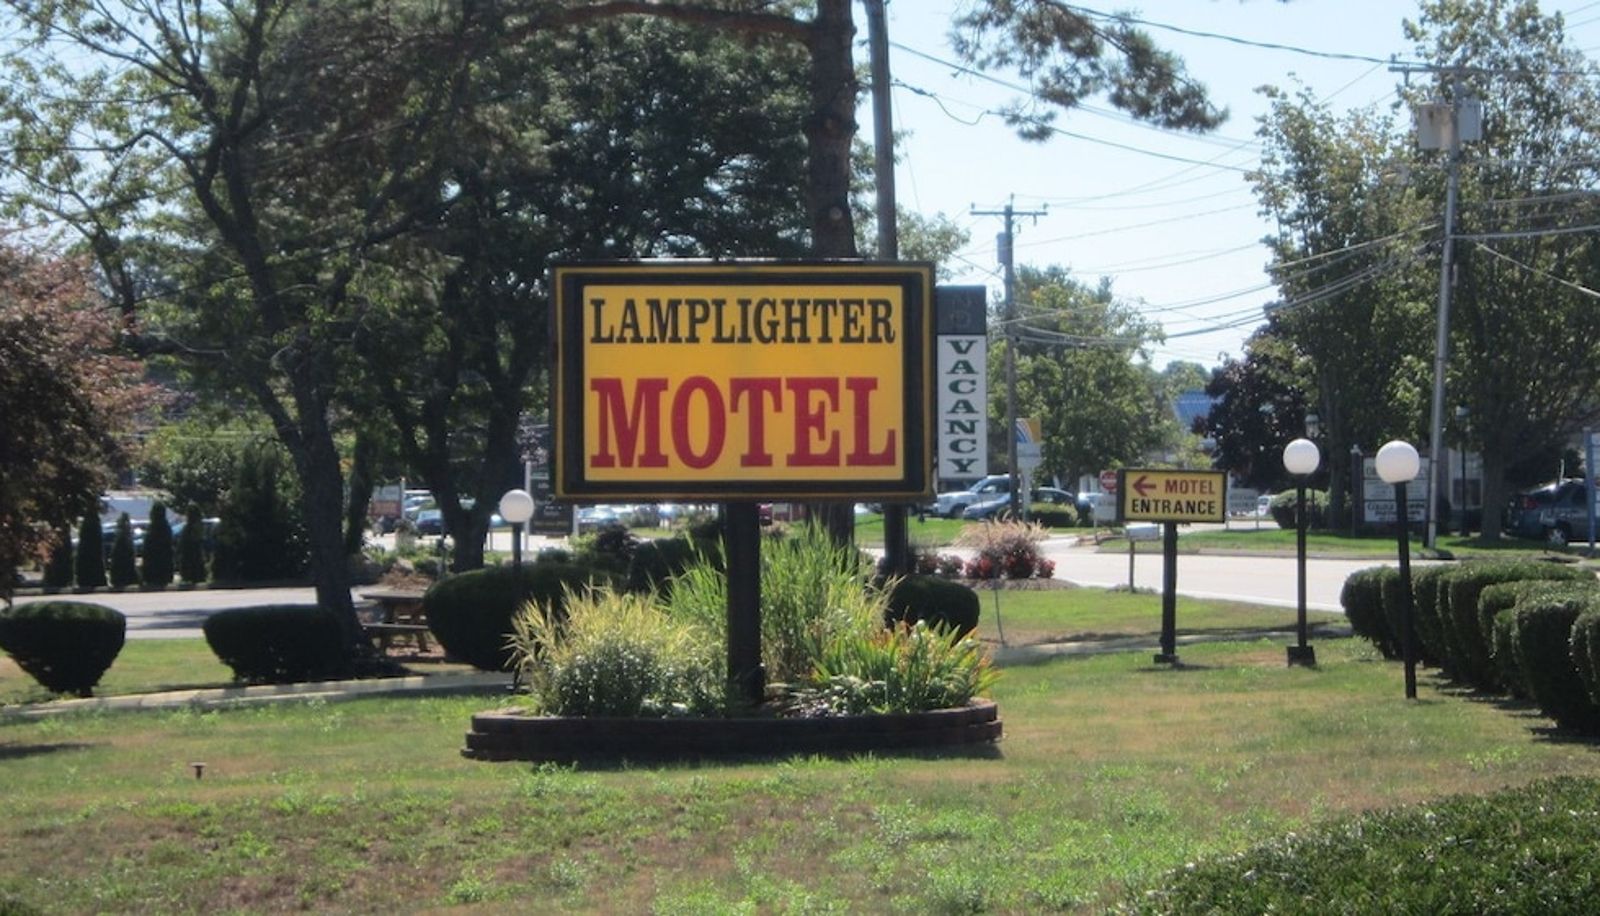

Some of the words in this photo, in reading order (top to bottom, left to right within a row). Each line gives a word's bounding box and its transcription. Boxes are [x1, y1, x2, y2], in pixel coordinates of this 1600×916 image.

[589, 298, 896, 344] LAMPLIGHTER
[589, 375, 897, 469] MOTEL
[945, 339, 980, 474] VACANCY
[1131, 498, 1216, 515] ENTRANCE
[1164, 479, 1216, 495] MOTEL
